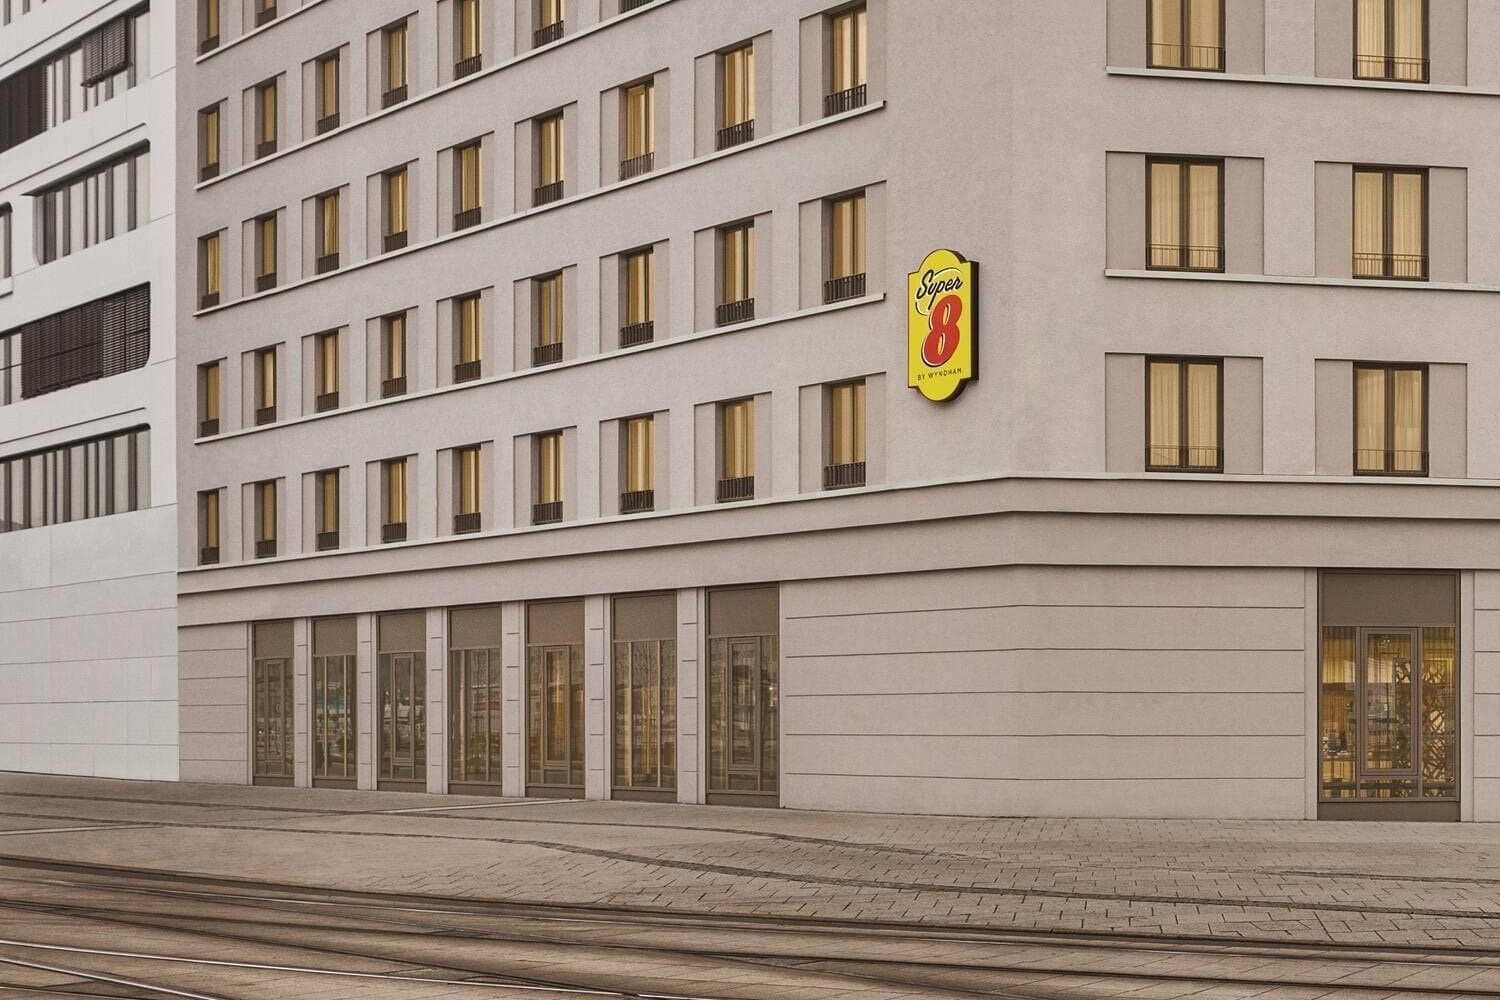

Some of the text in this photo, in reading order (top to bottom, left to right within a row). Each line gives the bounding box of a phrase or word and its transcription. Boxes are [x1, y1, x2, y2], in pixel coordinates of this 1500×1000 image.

[916, 268, 963, 311] Super
[921, 294, 963, 367] 8
[927, 367, 962, 379] WYNDHAM
